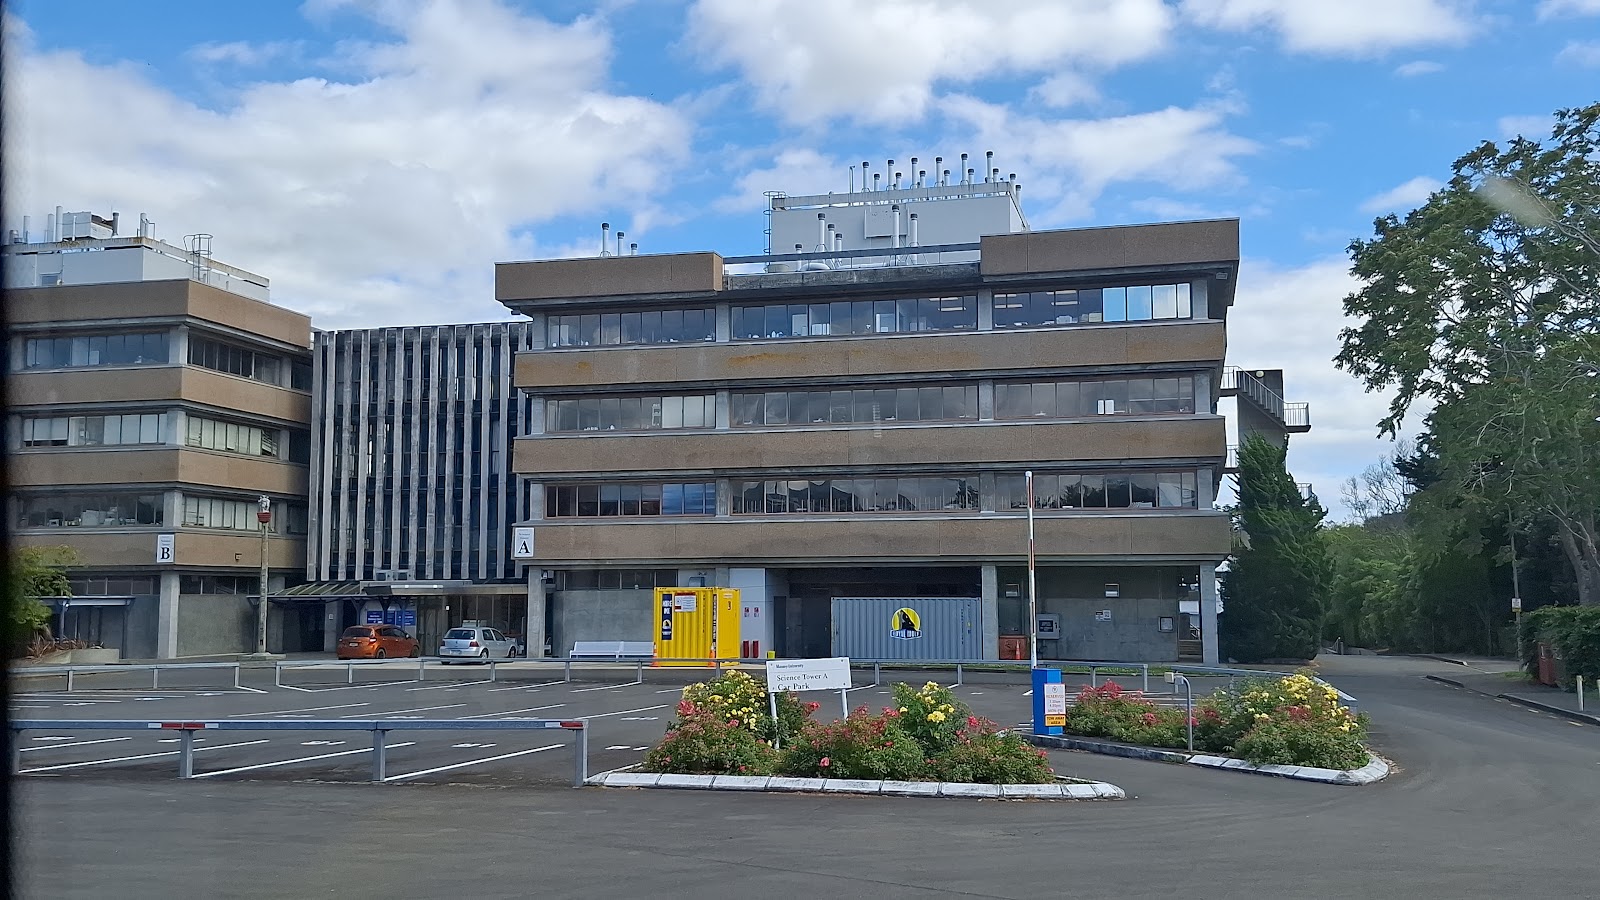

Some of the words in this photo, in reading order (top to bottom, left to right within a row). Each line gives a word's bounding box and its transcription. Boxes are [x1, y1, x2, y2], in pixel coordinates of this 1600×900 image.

[160, 546, 170, 559] B
[518, 540, 530, 553] A
[777, 683, 791, 691] Car
